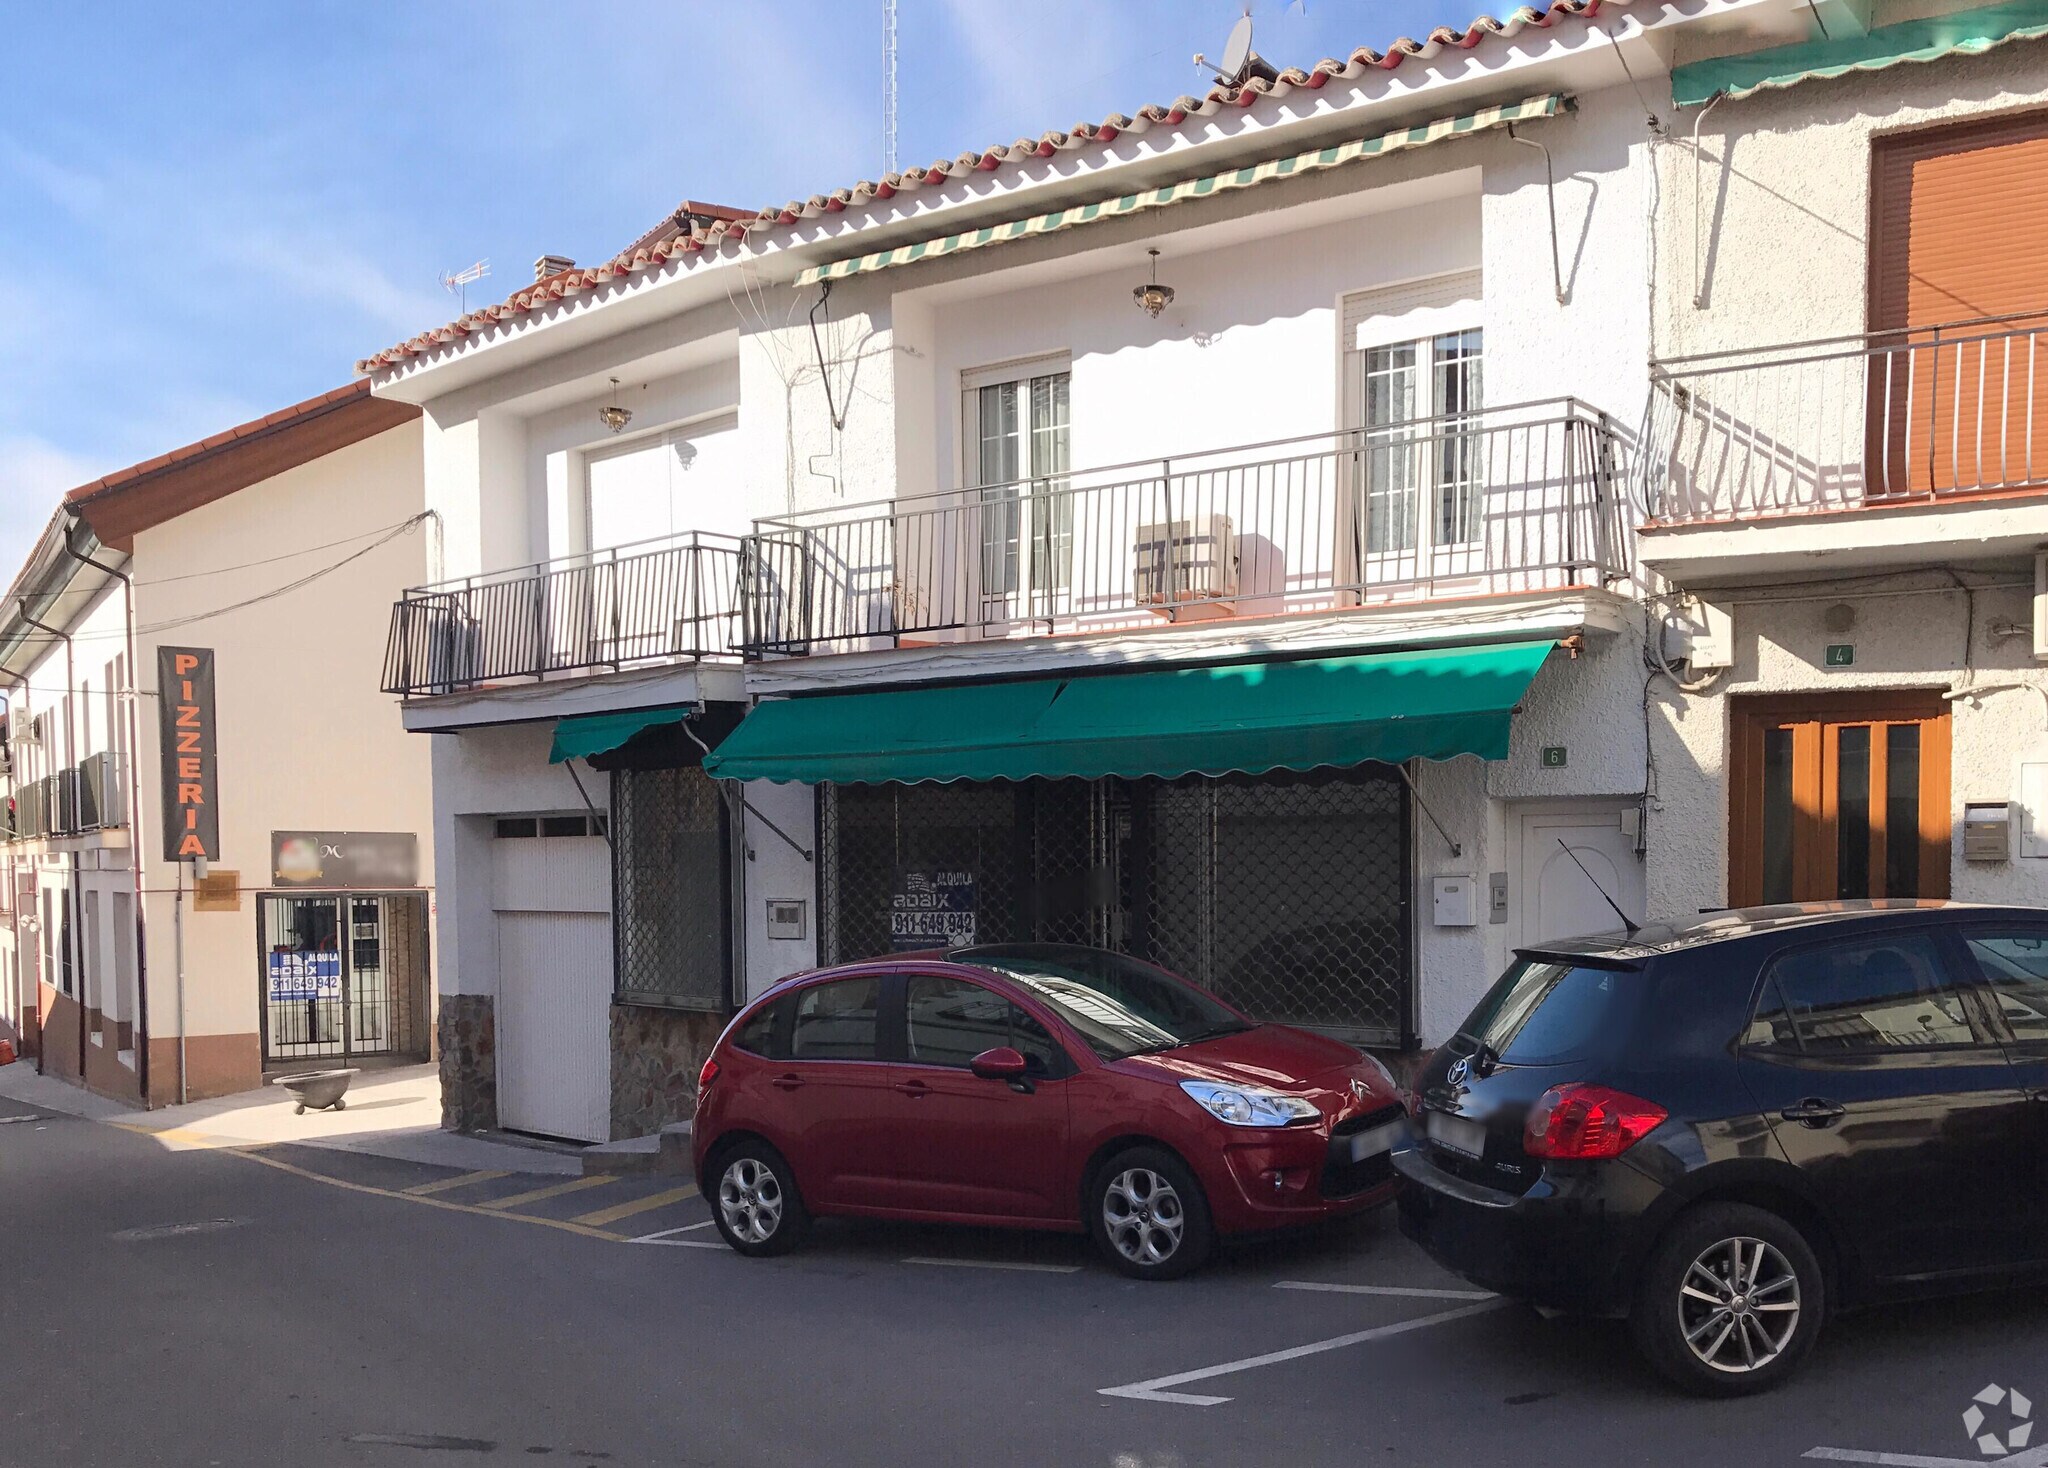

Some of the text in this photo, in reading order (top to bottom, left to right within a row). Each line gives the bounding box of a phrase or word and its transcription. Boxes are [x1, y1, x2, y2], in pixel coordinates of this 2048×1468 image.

[1836, 648, 1844, 662] 4
[175, 654, 206, 855] PIZZERIA
[1551, 750, 1558, 763] 6
[937, 872, 972, 886] ALQUILA
[895, 913, 972, 933] 911 649 942
[272, 976, 337, 990] 911 649 942
